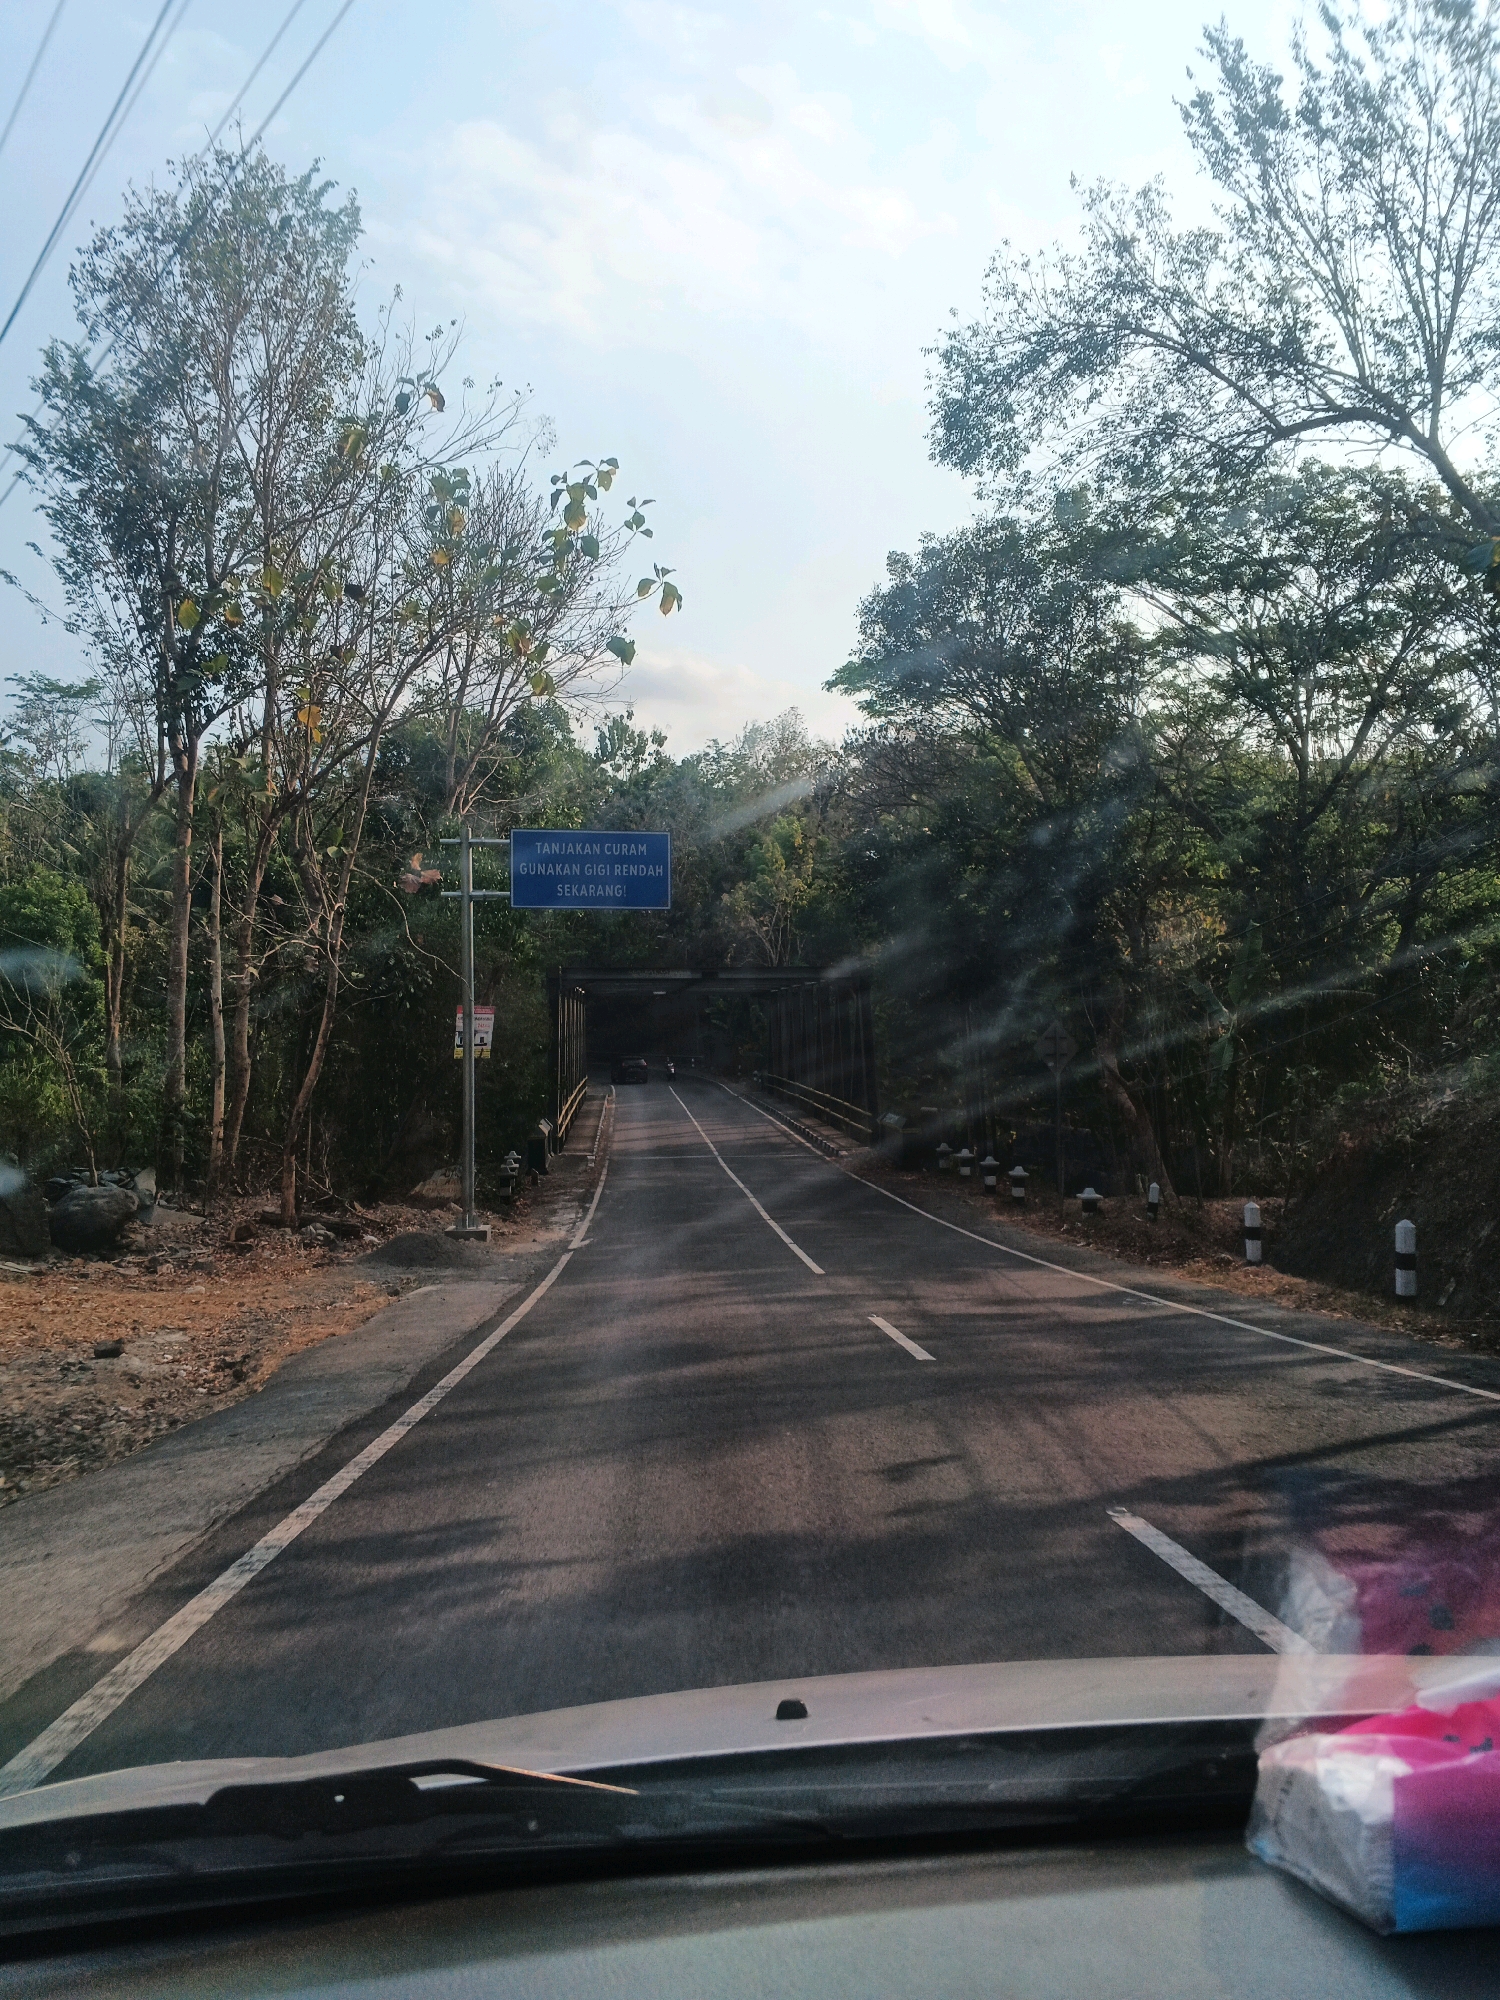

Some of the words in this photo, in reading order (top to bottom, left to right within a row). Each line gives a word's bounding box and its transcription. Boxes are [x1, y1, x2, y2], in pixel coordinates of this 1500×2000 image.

[536, 842, 600, 855] TANJAKAN
[605, 844, 647, 855] CURAM
[520, 863, 579, 875] GUNAKAN
[585, 864, 609, 876] GIGI
[615, 865, 663, 876] RENDAH
[557, 884, 627, 897] SEKARANG!
